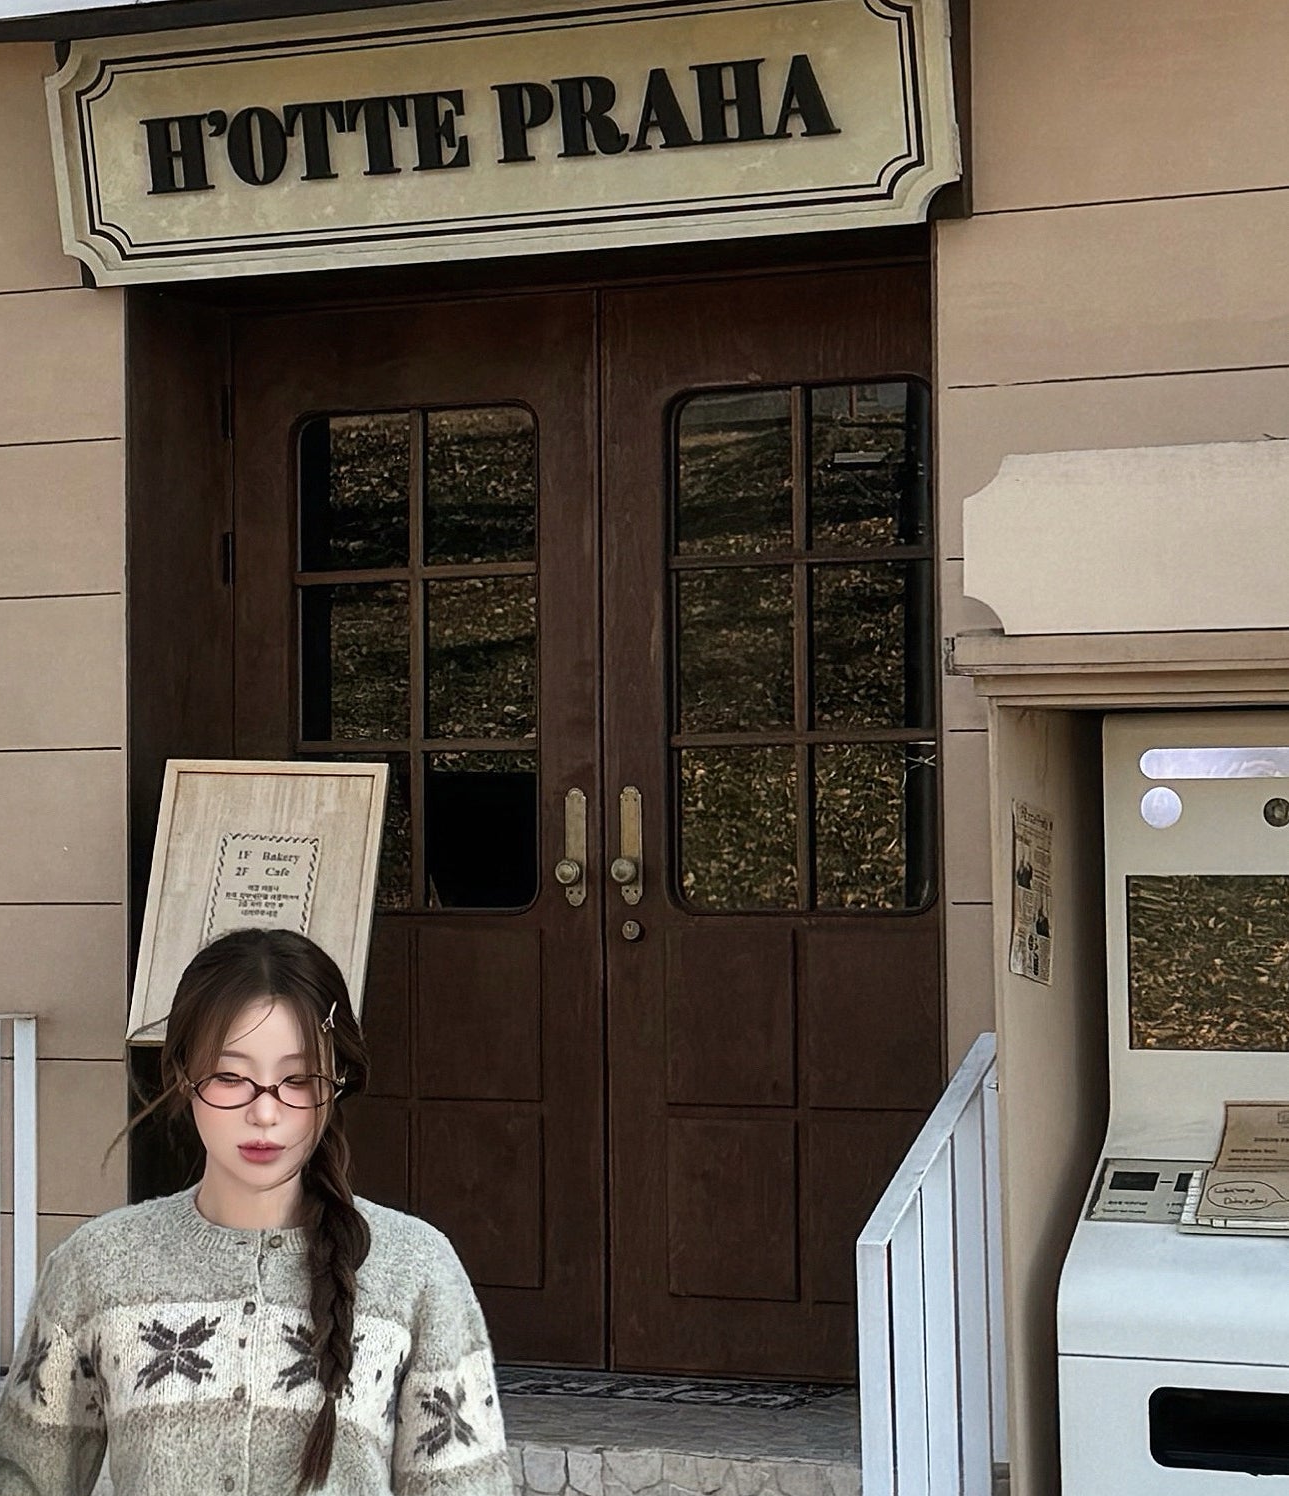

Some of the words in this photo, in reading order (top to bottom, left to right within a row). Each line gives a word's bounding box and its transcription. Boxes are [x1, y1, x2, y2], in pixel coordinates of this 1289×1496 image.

[138, 88, 470, 195] H'OTTE
[490, 54, 841, 164] PRAHA
[237, 850, 253, 860] 1F
[262, 851, 301, 865] Bakery
[235, 866, 250, 876] 2F
[265, 867, 291, 877] Cafe
